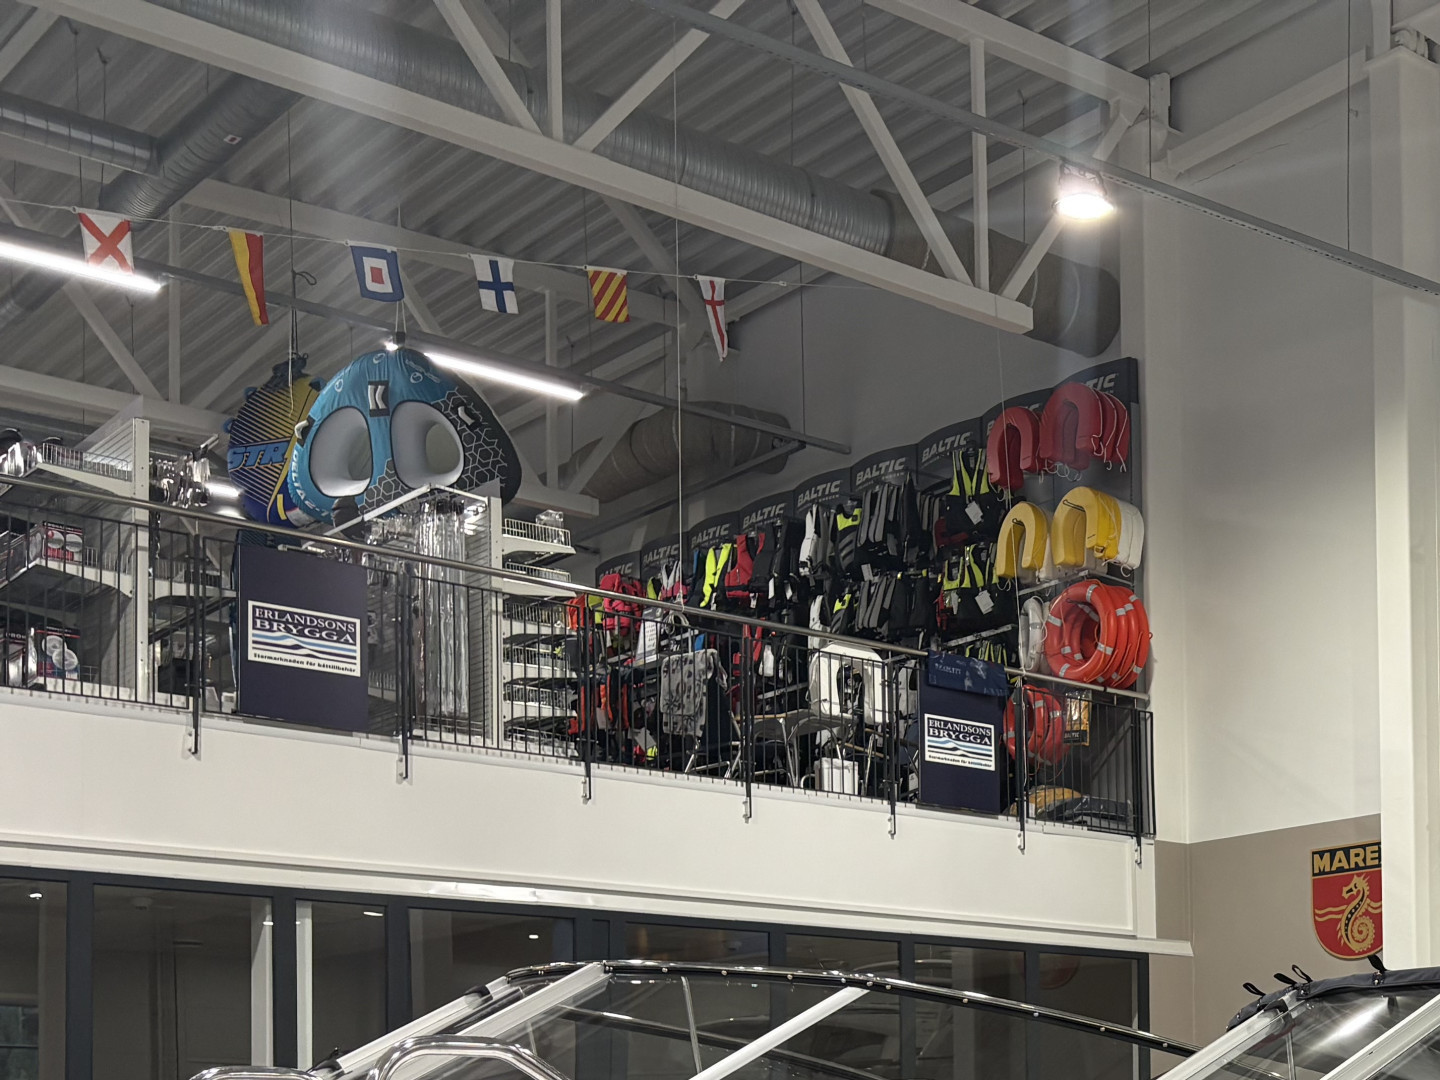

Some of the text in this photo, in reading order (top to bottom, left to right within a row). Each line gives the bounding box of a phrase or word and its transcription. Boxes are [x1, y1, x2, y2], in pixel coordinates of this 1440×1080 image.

[921, 432, 971, 462] BALTIC
[855, 457, 906, 486] BALTIC
[797, 479, 841, 507] BALTIC
[742, 503, 787, 529] BALTIC
[691, 523, 730, 548] BALTIC
[643, 543, 679, 563] BALTIC
[255, 608, 355, 633] ERLANDSONS
[255, 619, 355, 644] BRYGGA
[929, 719, 992, 736] ERLANDSONS
[929, 727, 991, 745] BRYGGA
[1313, 845, 1382, 874] MARE
